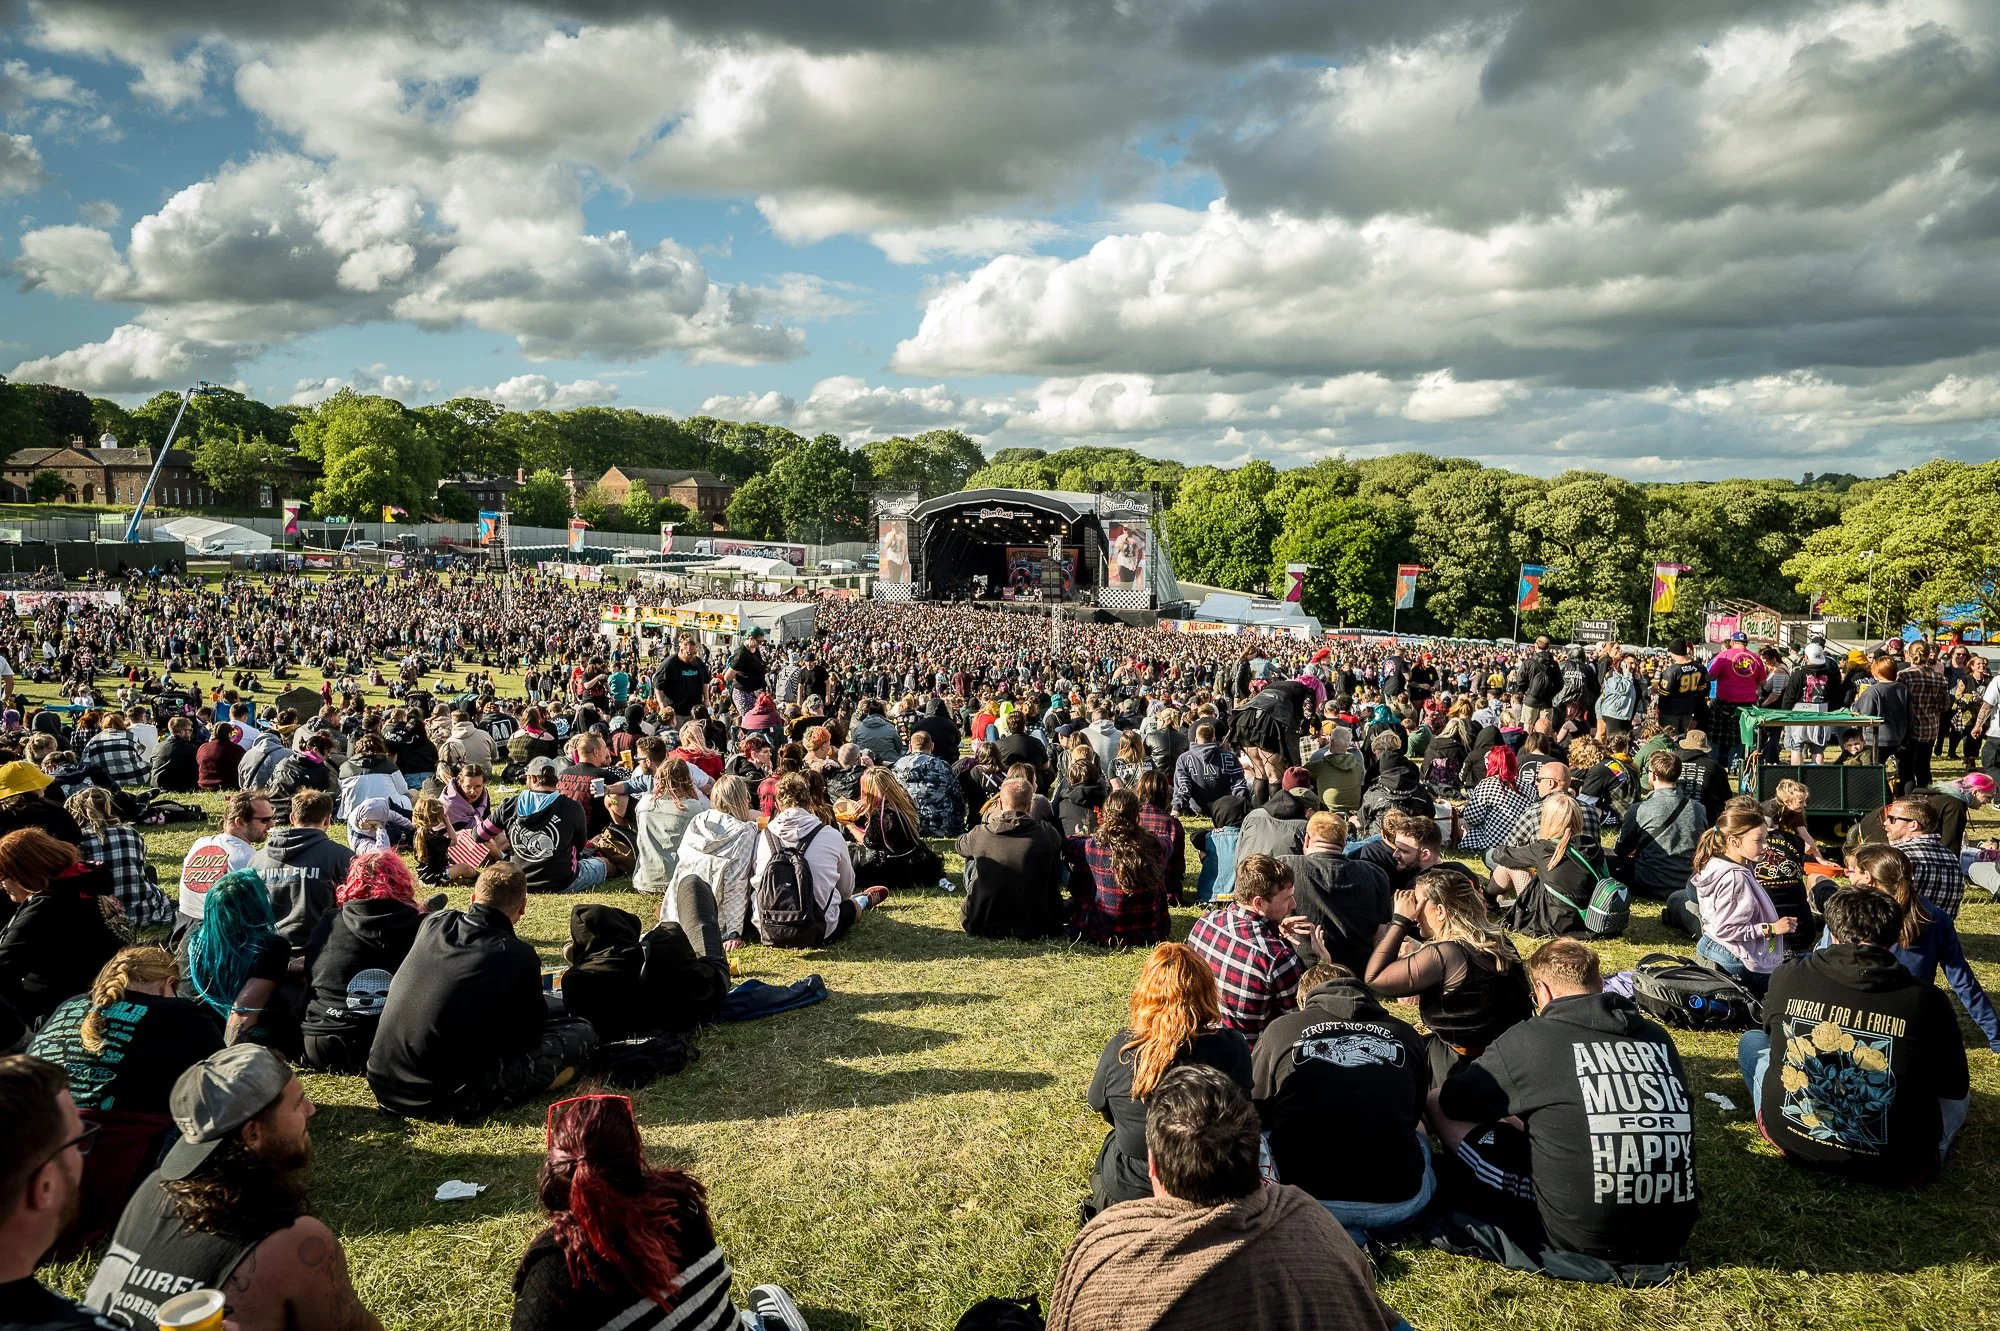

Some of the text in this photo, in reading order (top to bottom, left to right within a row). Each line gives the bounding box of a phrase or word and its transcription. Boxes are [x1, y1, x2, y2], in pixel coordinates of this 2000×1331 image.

[1581, 621, 1608, 630] TOILETS
[1822, 615, 1849, 623] WATER
[1582, 632, 1605, 640] URINALS
[1679, 671, 1702, 693] 90
[562, 774, 577, 782] YOU
[186, 853, 229, 868] SANTA
[183, 869, 222, 883] CRUZ
[292, 866, 320, 880] FUJI
[1784, 998, 1906, 1038] FUNERAL FOR A FRIEND
[1301, 1021, 1391, 1039] TRUST NO ONE
[1572, 1041, 1674, 1077] ANGRY
[1578, 1073, 1689, 1114] MUSIC
[1618, 1116, 1676, 1129] FOR
[1787, 1125, 1814, 1141] ROSES
[1815, 1138, 1833, 1147] FOR
[1834, 1143, 1852, 1151] THE
[1590, 1134, 1692, 1173] HAPPY
[1594, 1167, 1695, 1204] PEOPLE
